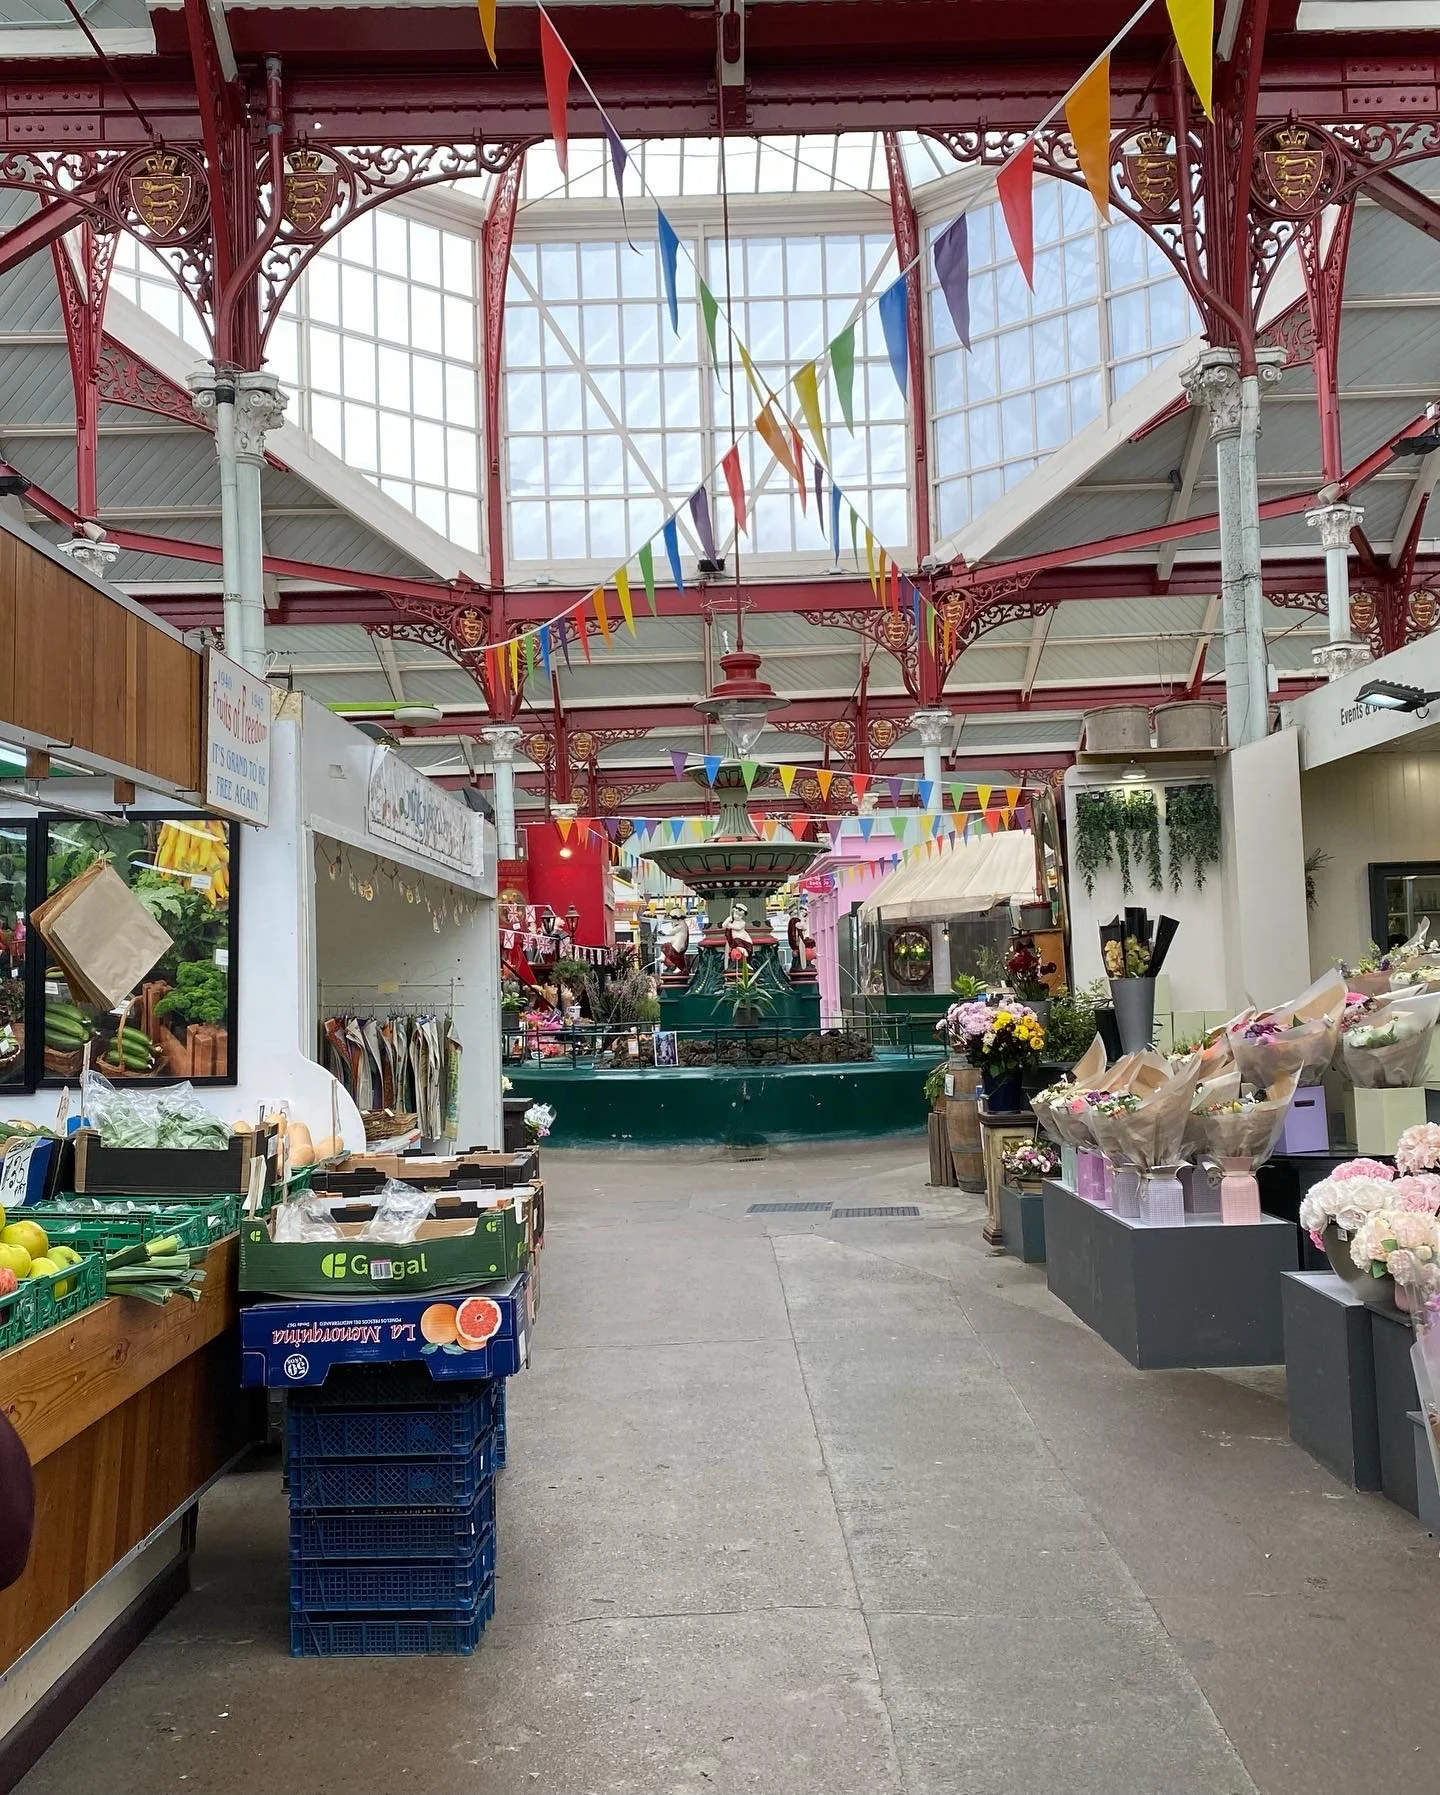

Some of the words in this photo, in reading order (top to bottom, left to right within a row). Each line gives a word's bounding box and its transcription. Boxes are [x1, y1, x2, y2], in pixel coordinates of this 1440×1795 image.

[213, 681, 232, 732] Fruits
[233, 698, 241, 739] of
[241, 684, 267, 744] Freedom
[1340, 703, 1363, 726] Events
[212, 742, 225, 767] IT'S
[226, 749, 248, 777] GRAND
[249, 760, 257, 782] TO
[258, 765, 266, 785] BE
[216, 775, 232, 800] FREE
[234, 783, 259, 811] AGAIN
[350, 1252, 428, 1280] Ggal
[271, 1322, 382, 1348] Menorquina
[390, 1323, 416, 1342] La
[287, 1361, 306, 1376] 50
